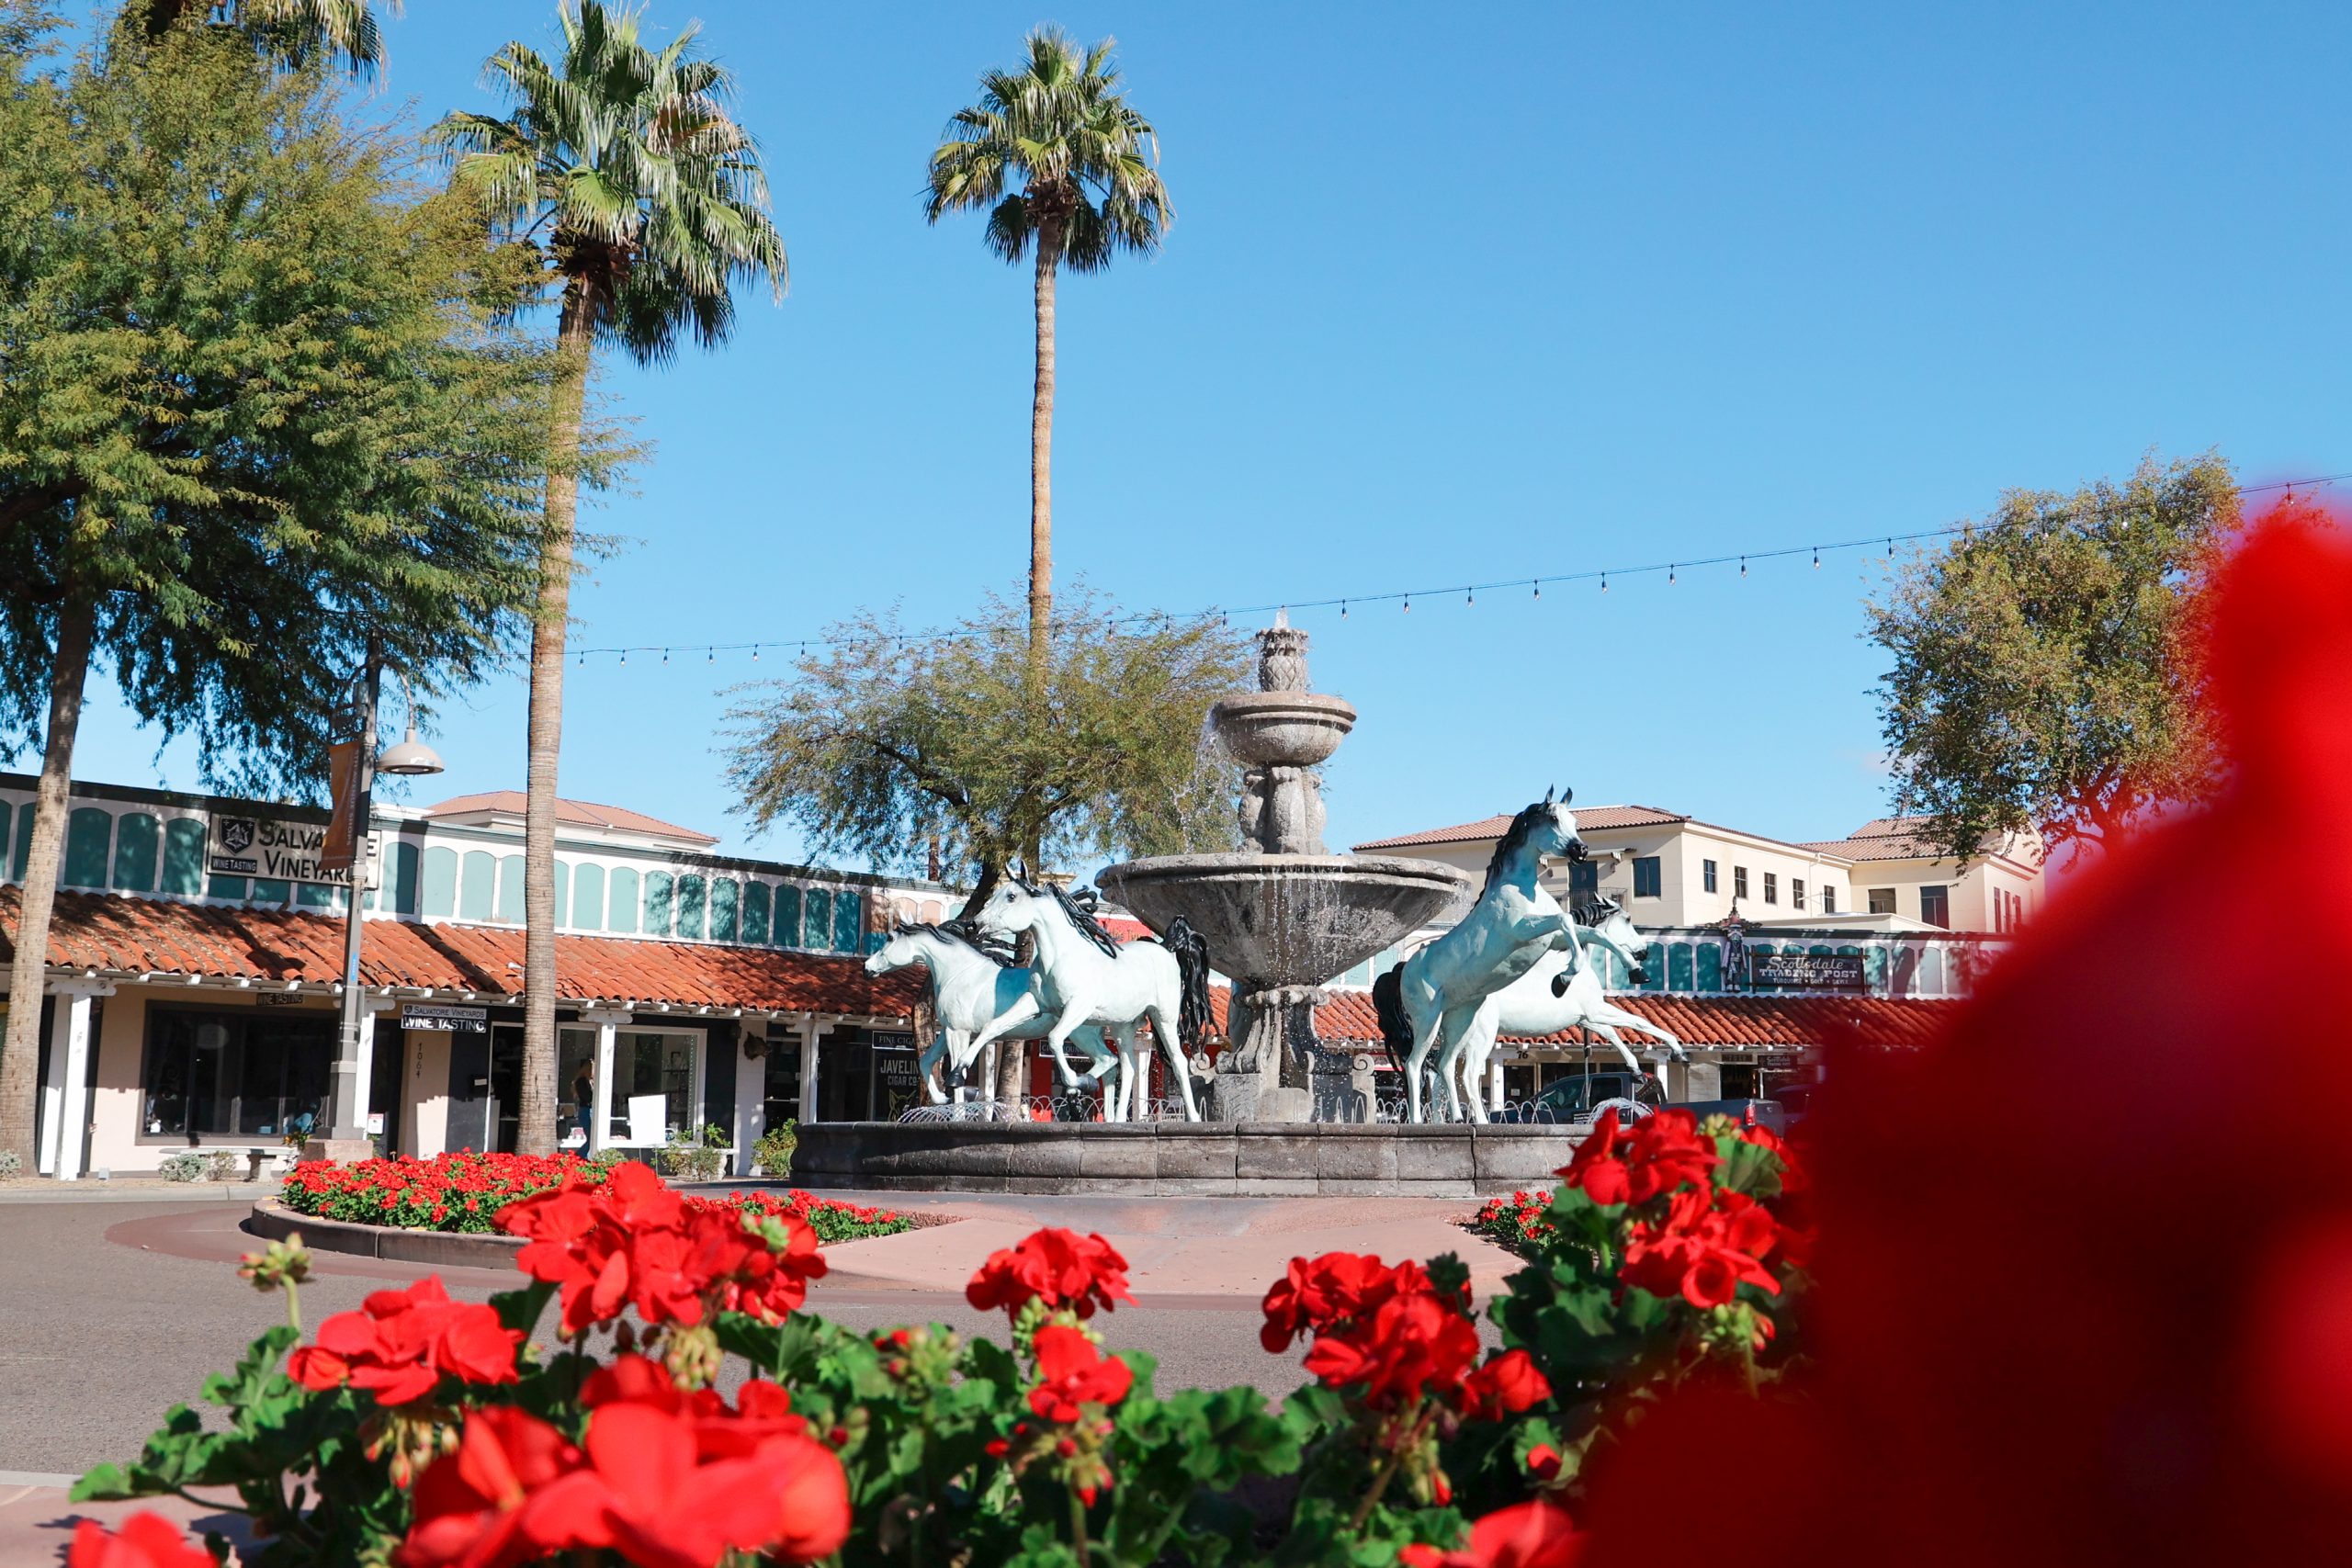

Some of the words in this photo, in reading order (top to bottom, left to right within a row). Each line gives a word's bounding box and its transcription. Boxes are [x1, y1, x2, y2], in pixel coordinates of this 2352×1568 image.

[258, 821, 377, 857] SALVAE
[212, 857, 230, 869] WINE
[230, 859, 256, 872] TASTING
[265, 849, 368, 883] VINEYAR
[1767, 956, 1843, 971] Scottsdale
[1758, 969, 1816, 977] TRADING
[1824, 970, 1858, 978] POST
[413, 1006, 449, 1016] SALVATORE
[452, 1009, 485, 1018] VINEYARDS
[404, 1017, 434, 1029] WINE
[436, 1018, 485, 1031] TASTING
[878, 1035, 896, 1044] FINE
[897, 1037, 916, 1045] CIGA
[880, 1059, 919, 1075] JAVELIN
[888, 1076, 907, 1086] CIGAR
